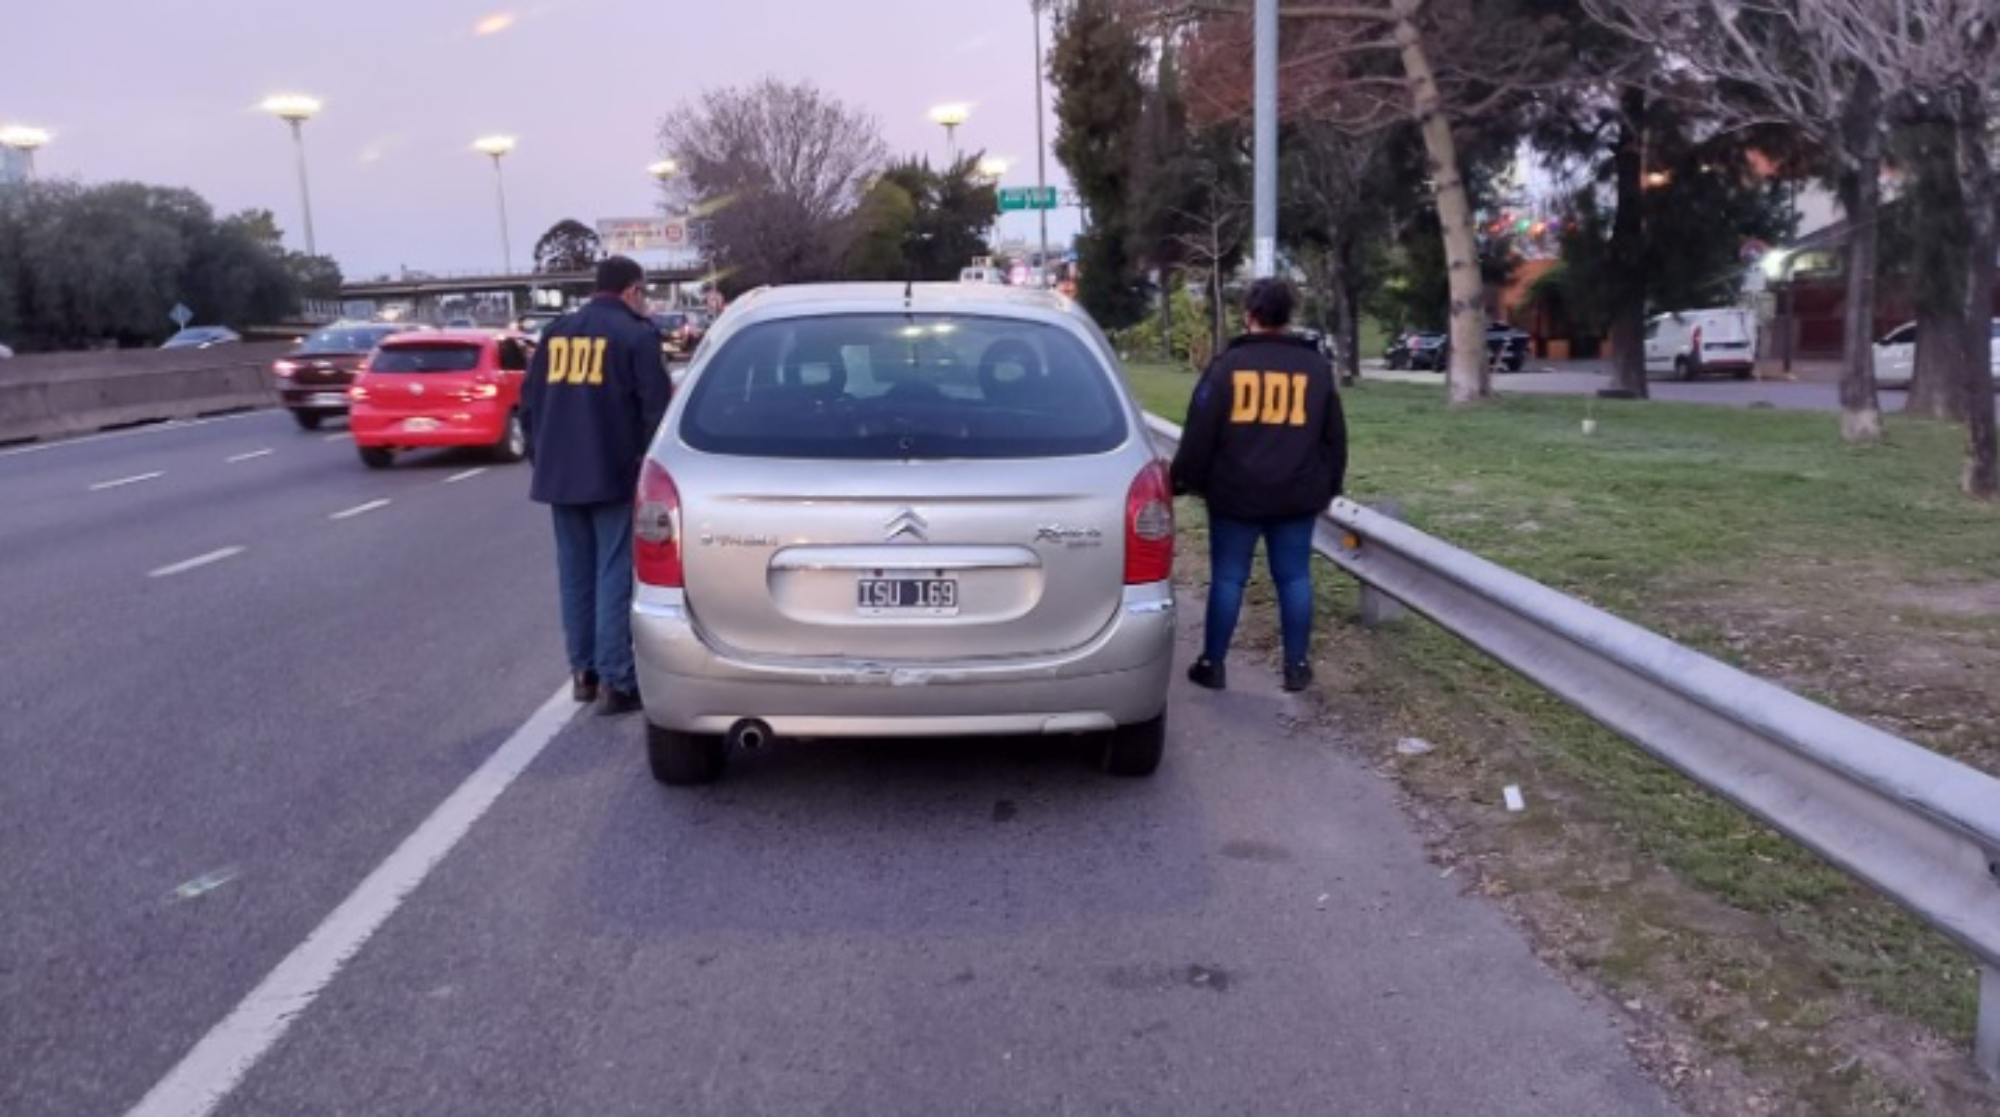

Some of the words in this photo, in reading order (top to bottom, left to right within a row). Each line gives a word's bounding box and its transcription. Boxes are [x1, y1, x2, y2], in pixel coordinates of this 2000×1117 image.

[547, 336, 607, 384] DDI
[1231, 370, 1308, 425] DDI
[861, 581, 900, 606] ISU
[914, 581, 955, 606] 169
